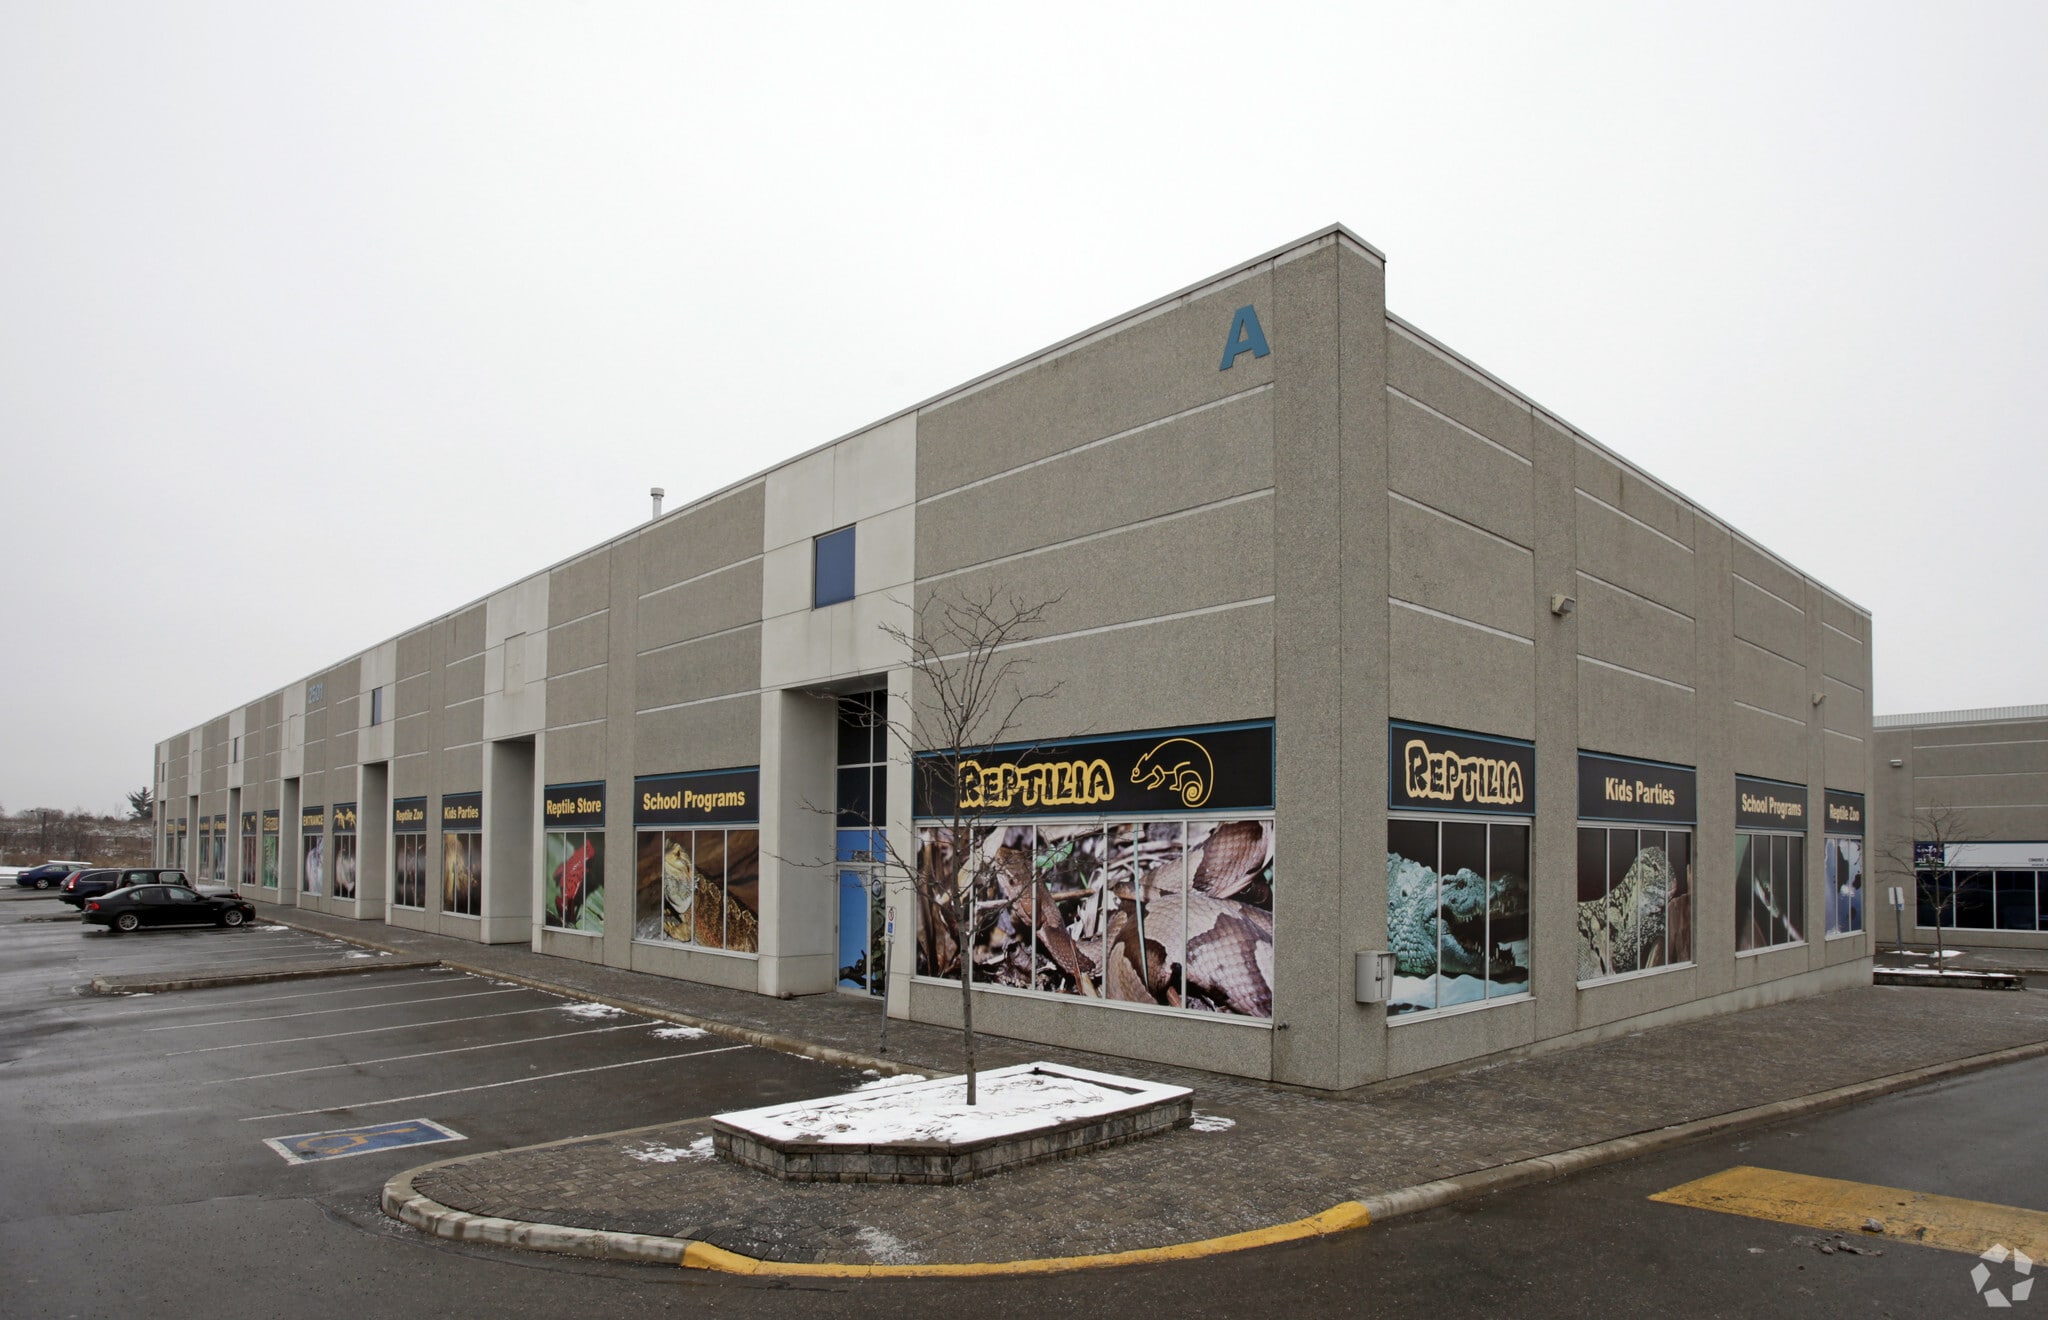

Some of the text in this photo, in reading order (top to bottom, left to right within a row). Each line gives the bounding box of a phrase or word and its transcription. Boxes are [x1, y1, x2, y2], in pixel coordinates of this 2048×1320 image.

[1219, 304, 1270, 371] A
[643, 790, 746, 812] School Programs
[1605, 776, 1675, 806] Kids Parties
[396, 808, 424, 824] Reptile Zoo
[444, 805, 479, 819] Kids Parties
[546, 797, 602, 818] Reptile Store
[1742, 793, 1802, 819] School Programs
[1829, 803, 1860, 823] Reptile Zoo
